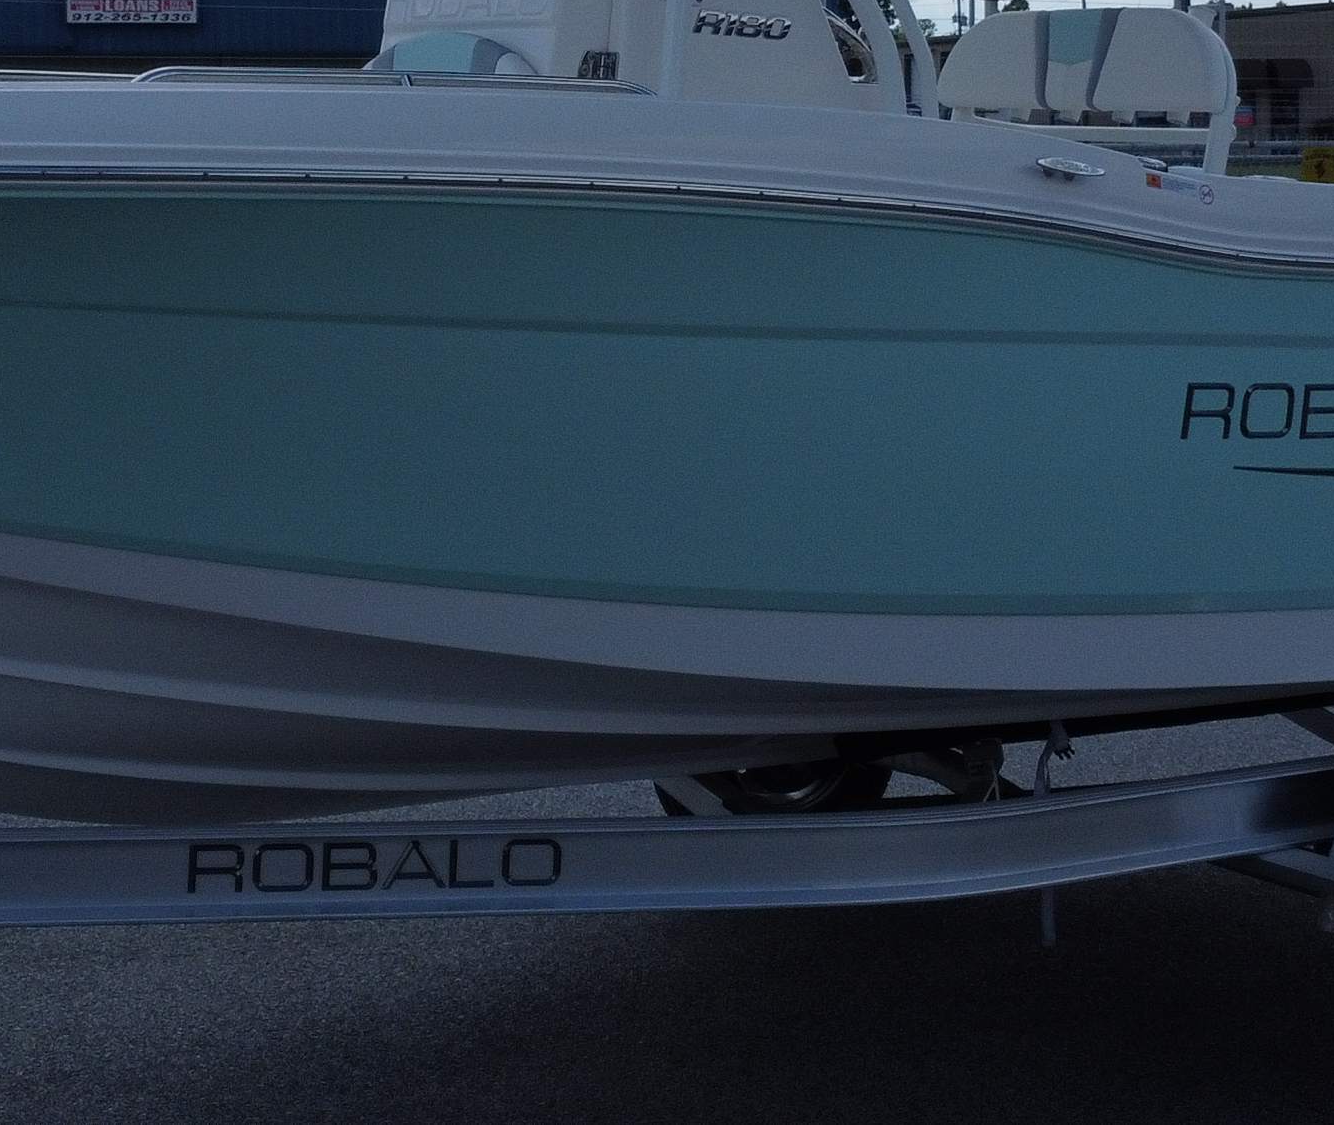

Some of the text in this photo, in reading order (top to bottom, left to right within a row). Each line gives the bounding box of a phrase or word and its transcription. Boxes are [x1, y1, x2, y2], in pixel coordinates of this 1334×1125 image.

[71, 13, 191, 21] 912-265-1336
[104, 0, 160, 12] LOANS
[693, 9, 791, 41] R180
[187, 838, 563, 893] ROBALO
